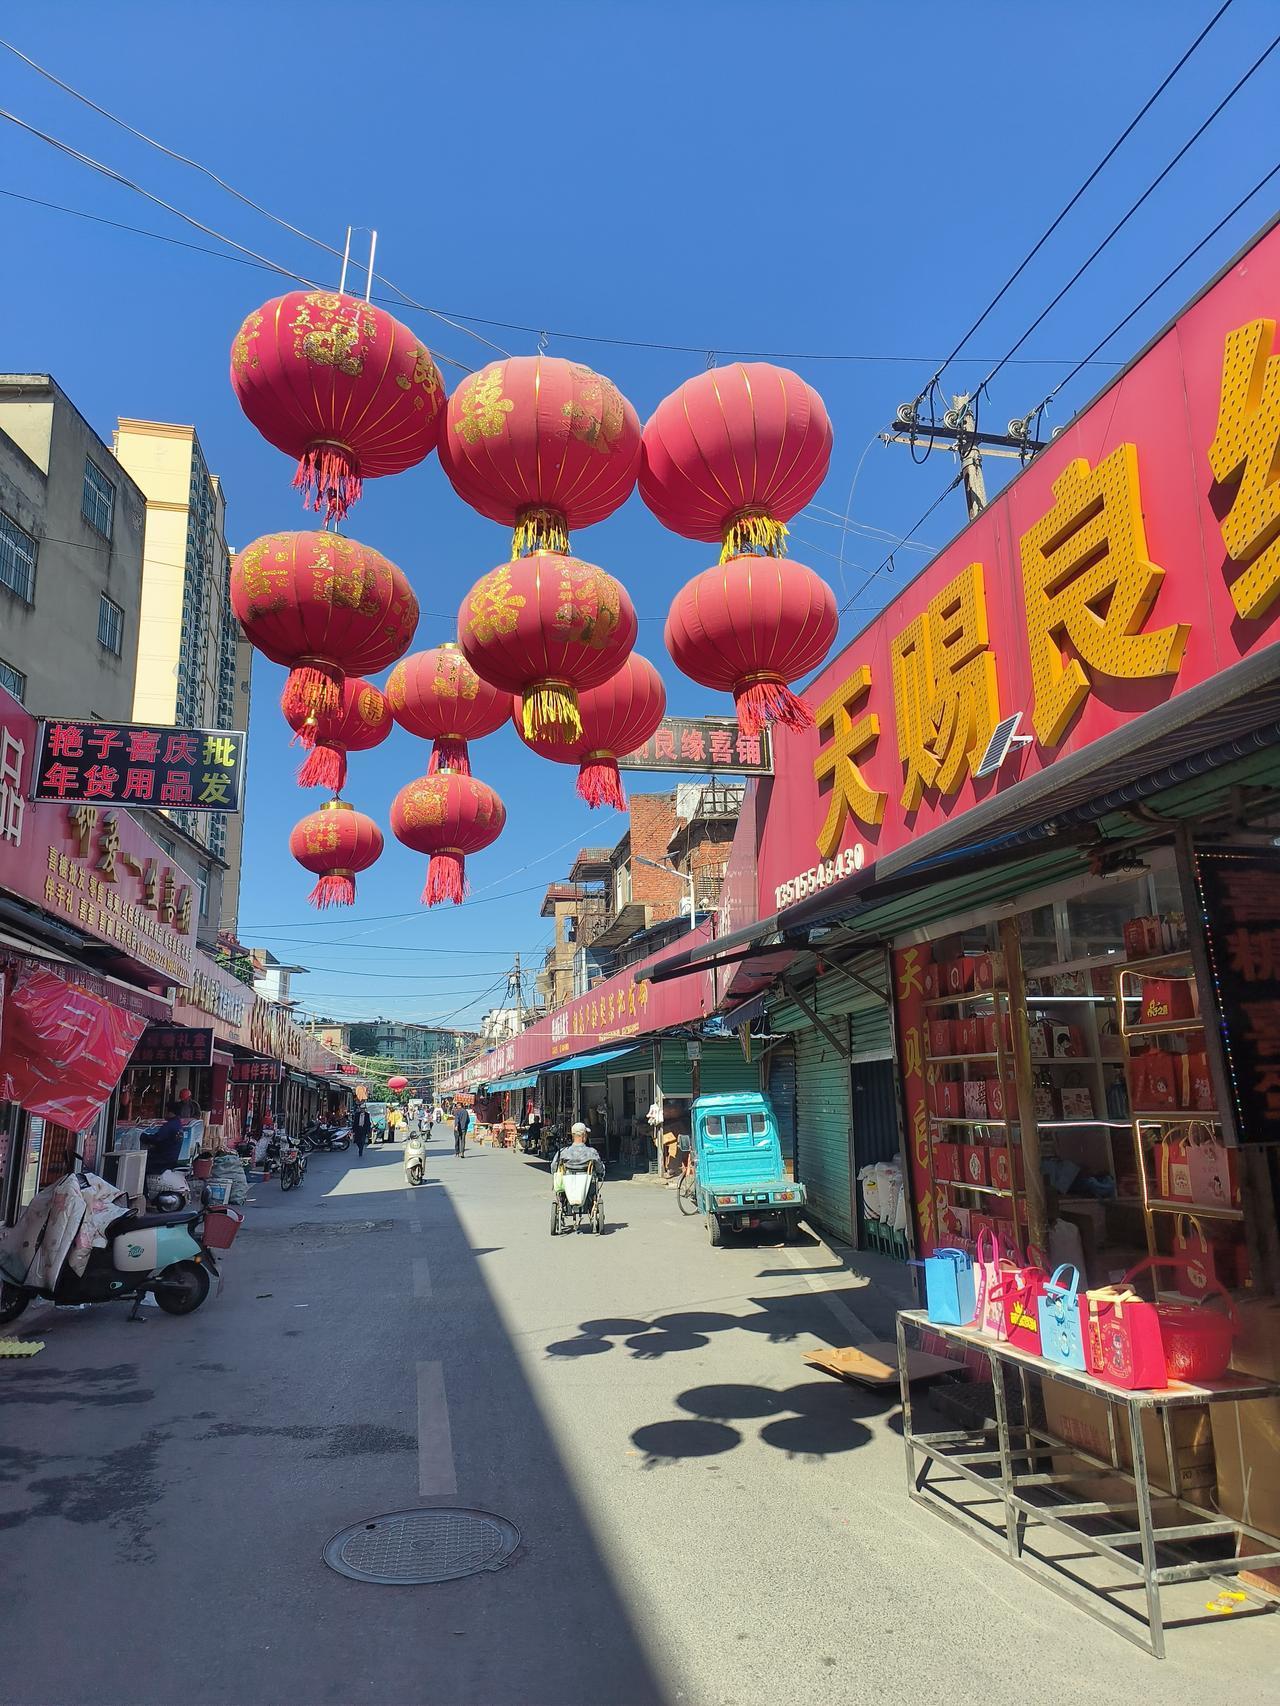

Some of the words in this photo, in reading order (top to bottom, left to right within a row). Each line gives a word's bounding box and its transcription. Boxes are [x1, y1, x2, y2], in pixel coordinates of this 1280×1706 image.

[47, 724, 200, 766] 艳子喜庆
[42, 762, 194, 802] 年货用品
